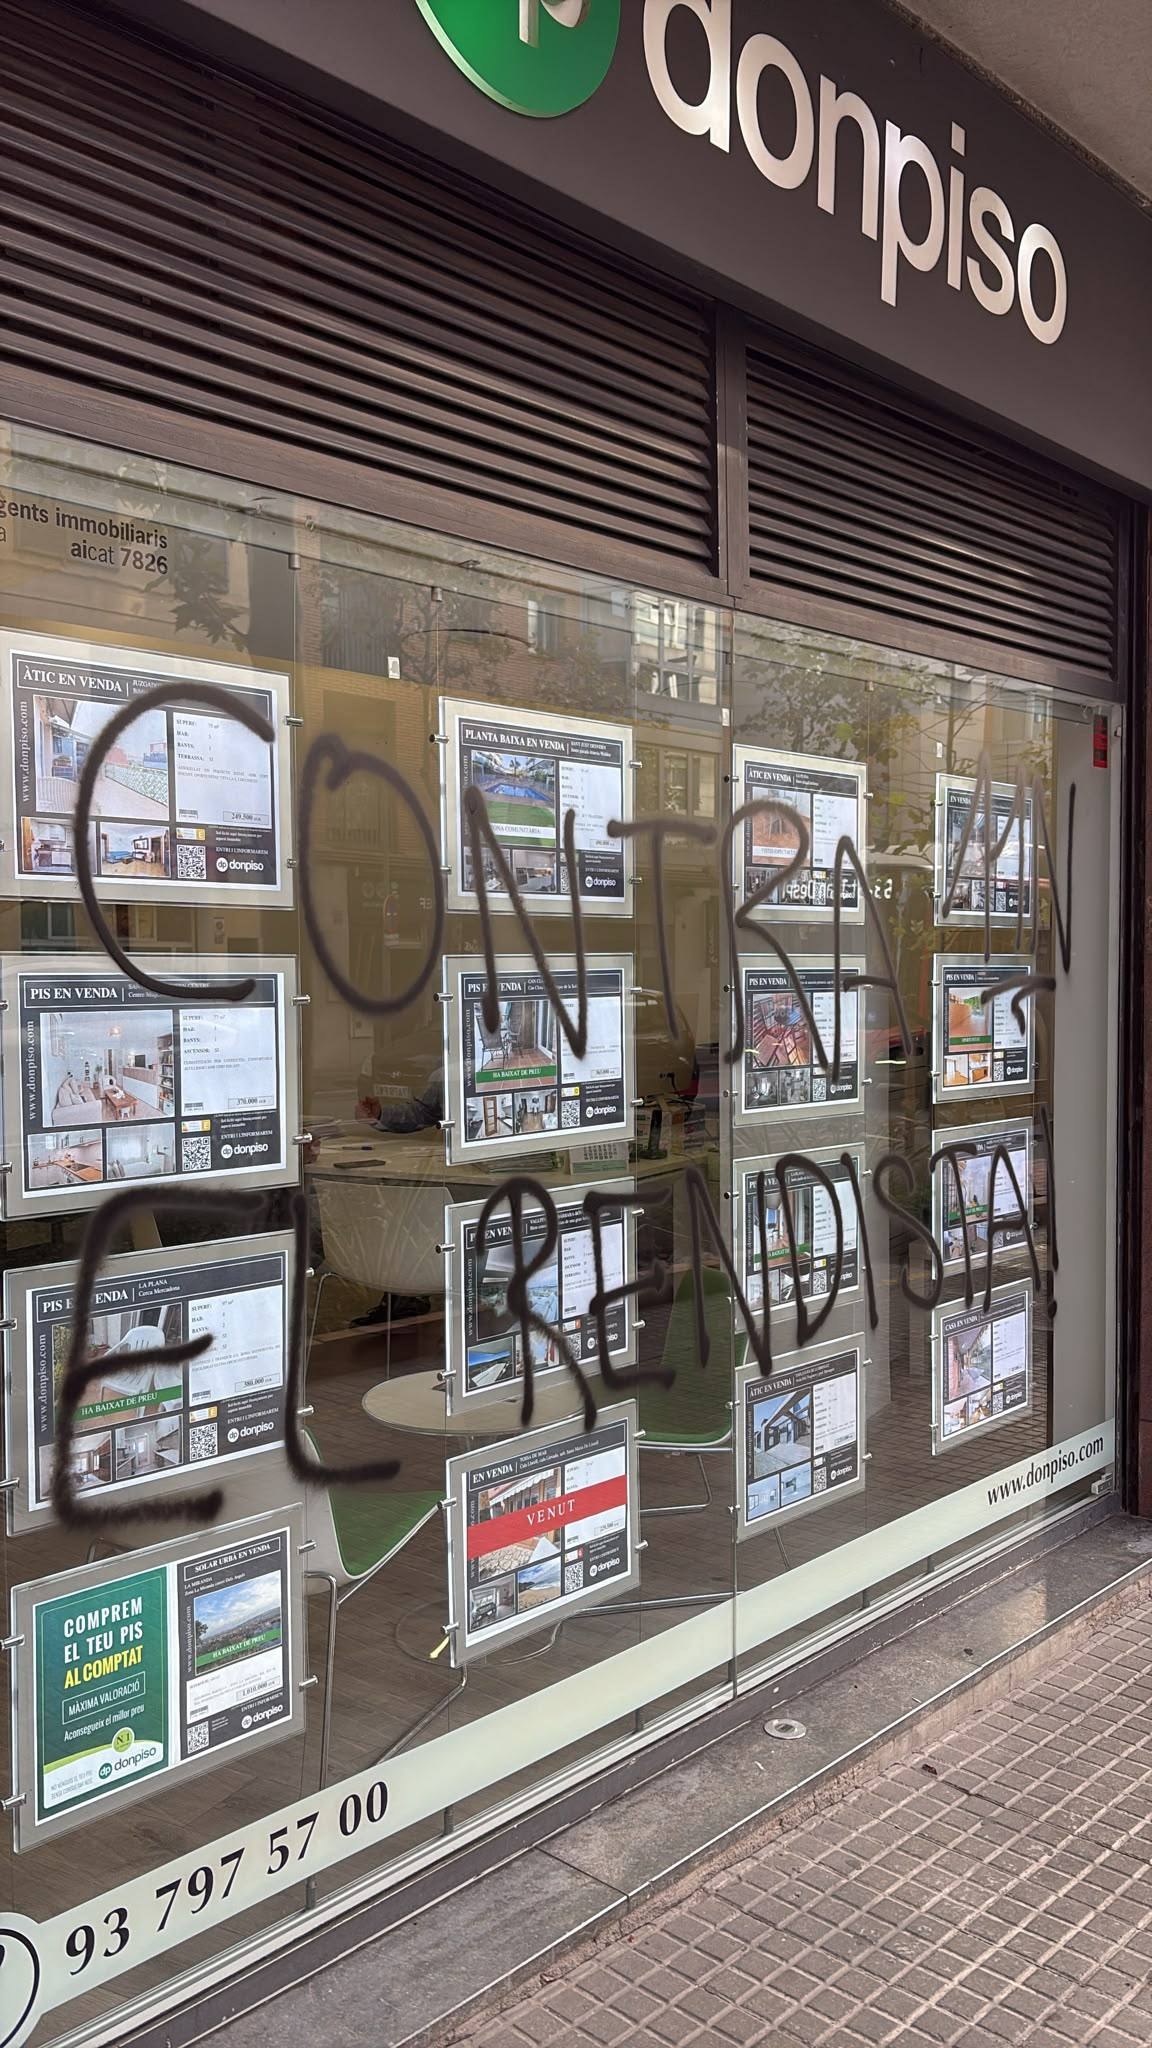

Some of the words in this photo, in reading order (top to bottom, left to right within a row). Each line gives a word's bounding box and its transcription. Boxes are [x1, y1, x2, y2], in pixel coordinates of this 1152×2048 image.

[642, 0, 1068, 345] donpiso
[56, 507, 168, 549] immobiliaris
[71, 540, 115, 565] aicat
[120, 547, 168, 575] 7826
[23, 665, 56, 683] ÀTIC
[58, 673, 76, 686] EN
[79, 675, 122, 692] VENDA
[21, 700, 30, 803] www.donpiso.com
[465, 729, 497, 742] PLANTA
[500, 735, 526, 746] BAIXA
[527, 738, 538, 748] EN
[539, 740, 565, 752] VENDA
[764, 770, 772, 781] EN
[772, 772, 792, 783] VENDA
[229, 858, 264, 872] donpiso
[72, 680, 914, 1086] CONTRA
[593, 877, 616, 888] donpiso
[30, 988, 51, 1000] PIS
[54, 987, 72, 999] EN
[76, 986, 118, 999] VENDA
[468, 983, 481, 993] PIS
[500, 982, 522, 992] ENDA
[749, 977, 758, 986] PIS
[759, 977, 768, 986] EN
[768, 977, 787, 986] VENDA
[26, 1020, 37, 1120] www.donpiso.com
[595, 1105, 616, 1115] donpiso
[234, 1142, 268, 1155] donpiso
[43, 1300, 63, 1312] PIS
[95, 1289, 128, 1304] ENDA
[53, 1183, 401, 1530] EL
[38, 1334, 47, 1432] www.donpiso.com
[764, 1384, 772, 1393] EN
[773, 1378, 792, 1390] VENDA
[81, 1405, 94, 1416] HA
[95, 1400, 124, 1413] BAIXAT
[126, 1397, 138, 1408] DE
[139, 1392, 158, 1405] PREU
[240, 1421, 274, 1437] donpiso
[473, 1470, 485, 1484] EN
[487, 1463, 513, 1480] VENDA
[987, 1436, 1104, 1506] www.donpiso.com
[527, 1499, 575, 1526] VENUT
[195, 1560, 218, 1573] SOLAR
[218, 1552, 237, 1565] URBÀ
[238, 1549, 248, 1559] EN
[248, 1543, 271, 1555] VENDA
[598, 1558, 619, 1572] donpiso
[64, 1597, 142, 1638] COMPREM
[64, 1643, 80, 1664] EL
[86, 1631, 113, 1654] TEU
[120, 1621, 143, 1644] PIS
[185, 1605, 193, 1673] www.donpiso.com
[222, 1642, 242, 1655] BAIXAT
[243, 1639, 251, 1647] DE
[64, 1668, 82, 1689] AL
[83, 1645, 143, 1683] COMPTAT
[68, 1694, 99, 1716] MÀXIMA
[100, 1679, 140, 1708] VALORACIÓ
[64, 1717, 105, 1742] Aconsegueix
[105, 1715, 111, 1727] el
[112, 1709, 130, 1725] millor
[131, 1705, 145, 1721] preu
[252, 1704, 283, 1722] donpiso
[114, 1747, 156, 1771] donpiso
[65, 1907, 130, 1976] 93
[156, 1847, 245, 1932] 797
[267, 1811, 319, 1875] 57
[339, 1781, 388, 1837] 00
